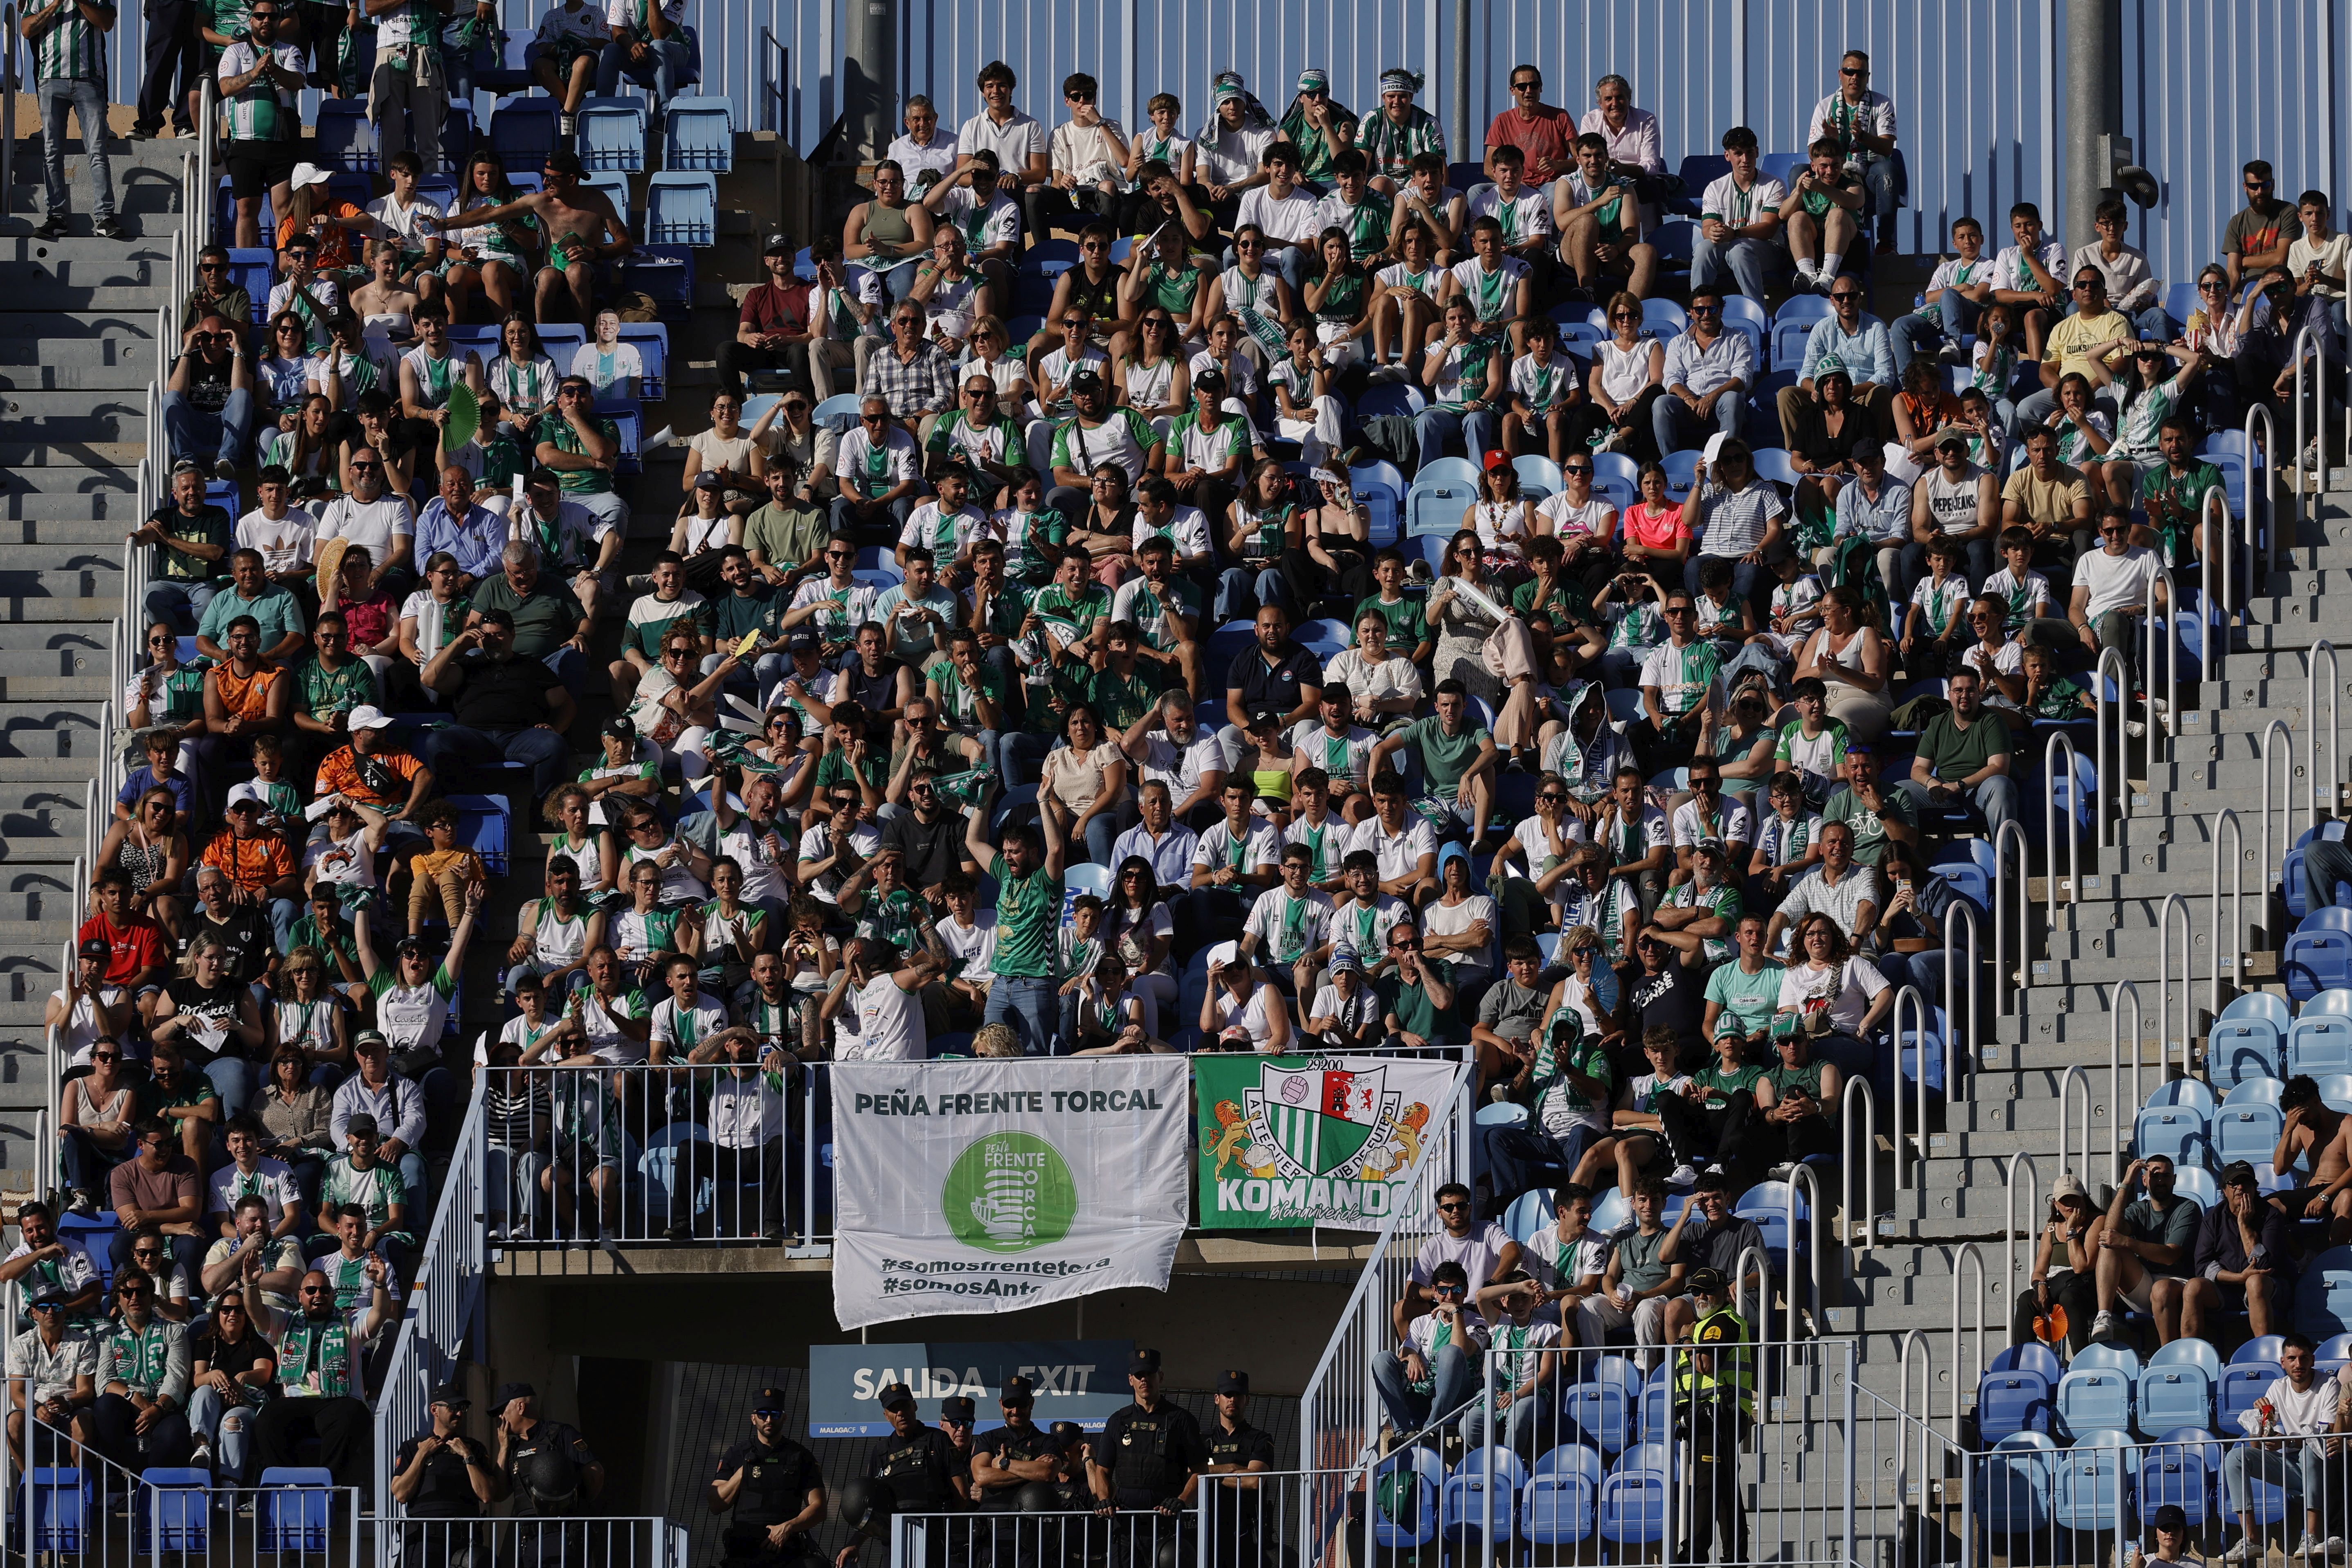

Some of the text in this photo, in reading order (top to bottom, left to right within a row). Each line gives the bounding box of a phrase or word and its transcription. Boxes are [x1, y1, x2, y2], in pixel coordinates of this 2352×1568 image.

[400, 230, 421, 241] Spotify
[1316, 313, 1354, 322] SERAINANT
[1439, 377, 1484, 387] enfocar
[1933, 495, 1976, 512] PEPE JEANS
[1660, 682, 1704, 691] enfocar
[2087, 879, 2095, 887] 13
[1284, 928, 1304, 940] má
[1279, 936, 1305, 950] laga
[963, 946, 981, 958] NIKE
[2221, 957, 2230, 965] 12
[2036, 965, 2045, 973] 12
[1633, 970, 1672, 1001] JACK &
[1635, 980, 1674, 1012] JONES
[179, 1003, 235, 1018] Mickey
[395, 1014, 427, 1022] Castello
[358, 1032, 371, 1041] CAT
[1306, 1058, 1343, 1071] 29200
[855, 1088, 1163, 1116] PEÑA FRENTE TORCAL
[1546, 1095, 1567, 1103] Cast
[728, 1123, 760, 1133] Cstello
[2124, 1131, 2132, 1139] 10
[985, 1141, 1010, 1154] PEÑA
[984, 1153, 1046, 1167] FRENTE
[1269, 1201, 1363, 1223] Blanquiverde
[853, 1367, 987, 1400] SALIDA
[1017, 1365, 1096, 1396] EXIT
[1967, 1395, 1972, 1403] 7
